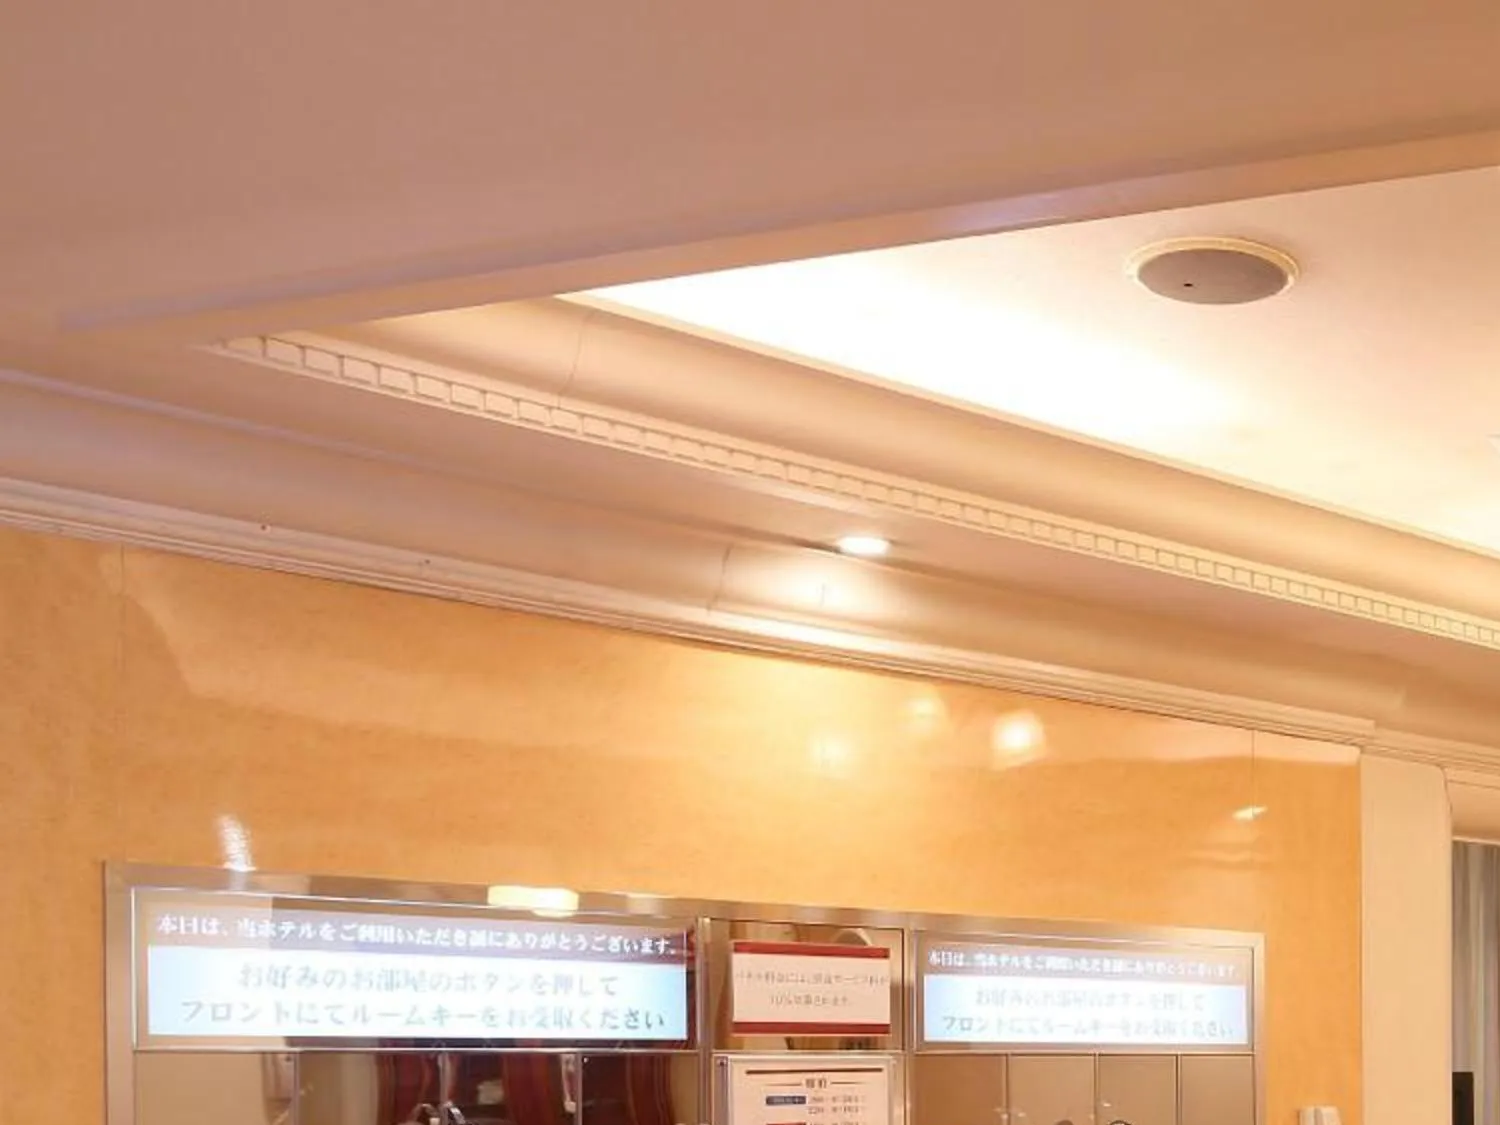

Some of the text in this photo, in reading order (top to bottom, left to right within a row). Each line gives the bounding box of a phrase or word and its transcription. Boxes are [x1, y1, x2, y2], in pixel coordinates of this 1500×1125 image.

[238, 962, 620, 998] お好みのお部屋のボタンを押して
[181, 1000, 667, 1031] フロントにてルームキーをお受取ください
